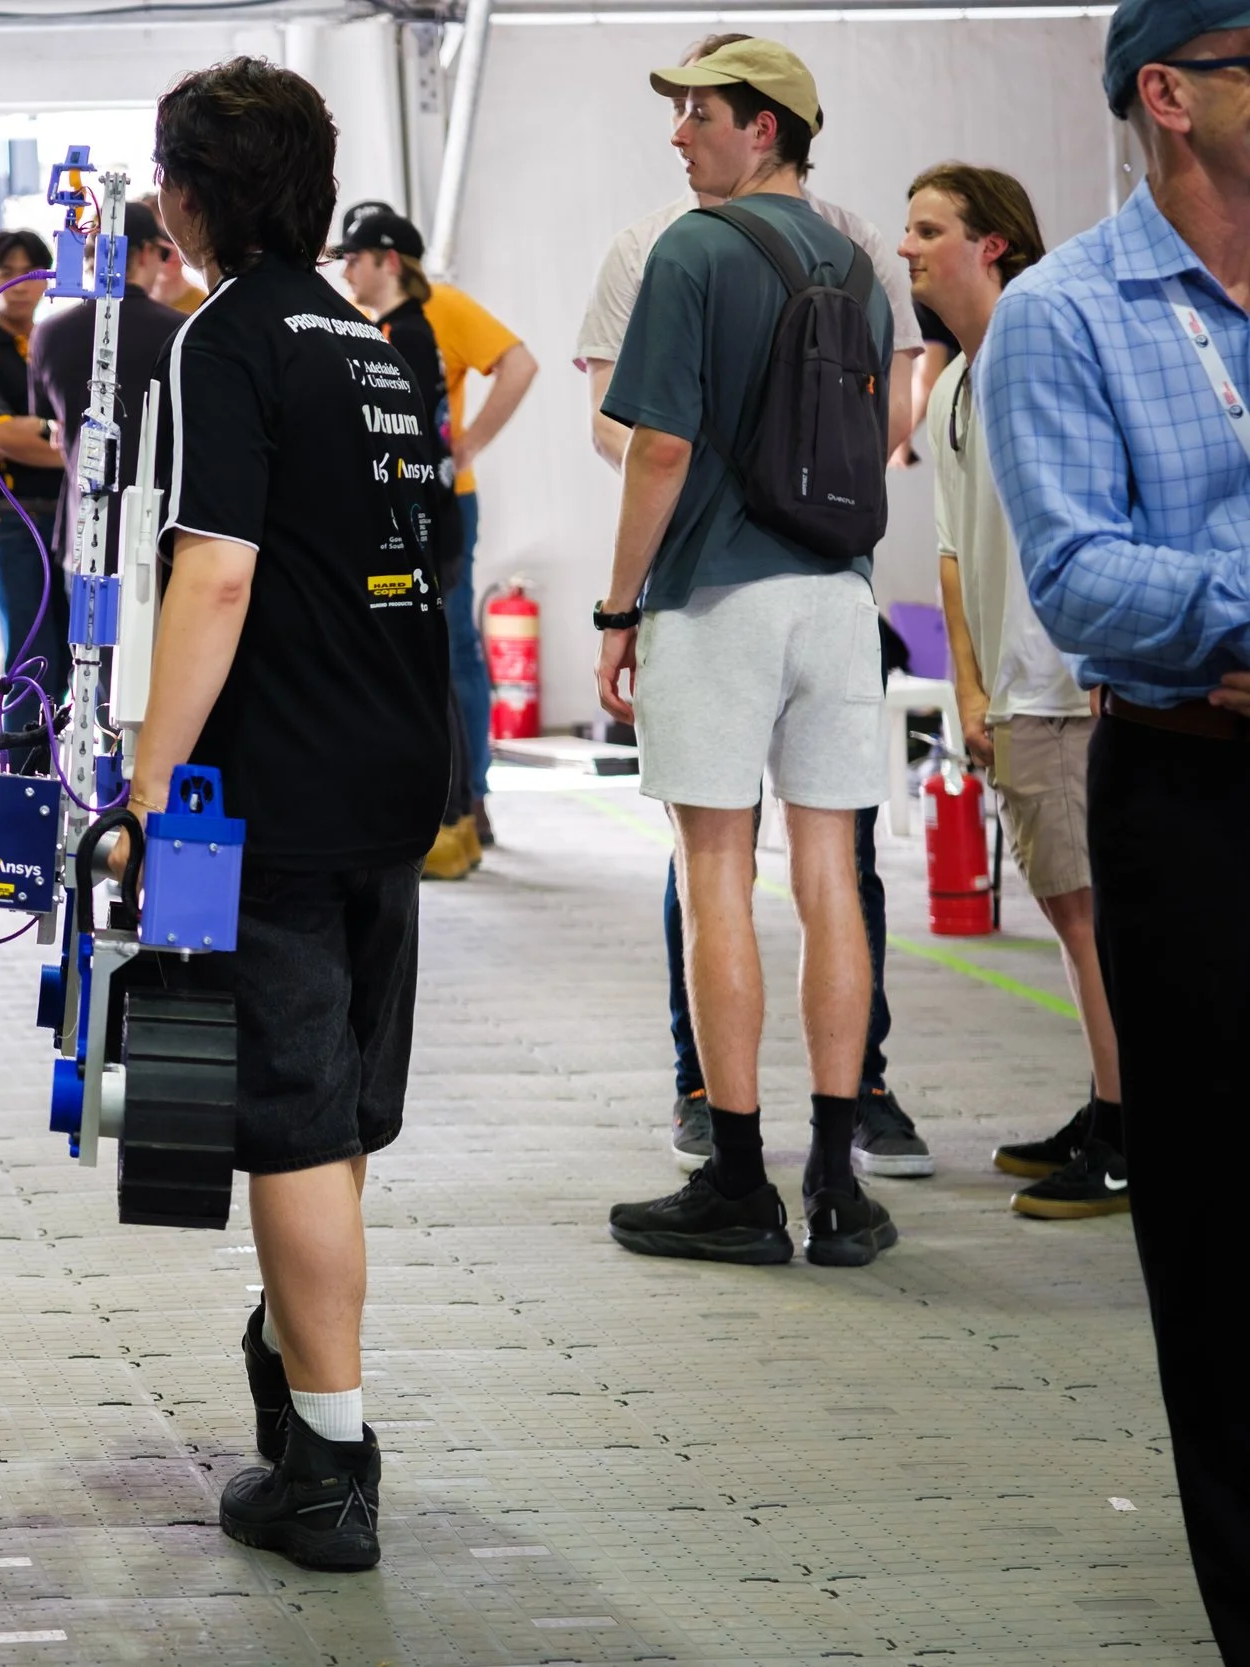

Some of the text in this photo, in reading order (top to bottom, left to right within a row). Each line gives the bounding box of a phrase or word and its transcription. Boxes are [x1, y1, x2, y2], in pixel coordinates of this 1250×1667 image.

[363, 360, 401, 376] Adelaide
[367, 374, 412, 394] University
[397, 458, 435, 483] Ansys
[373, 588, 407, 598] CORE
